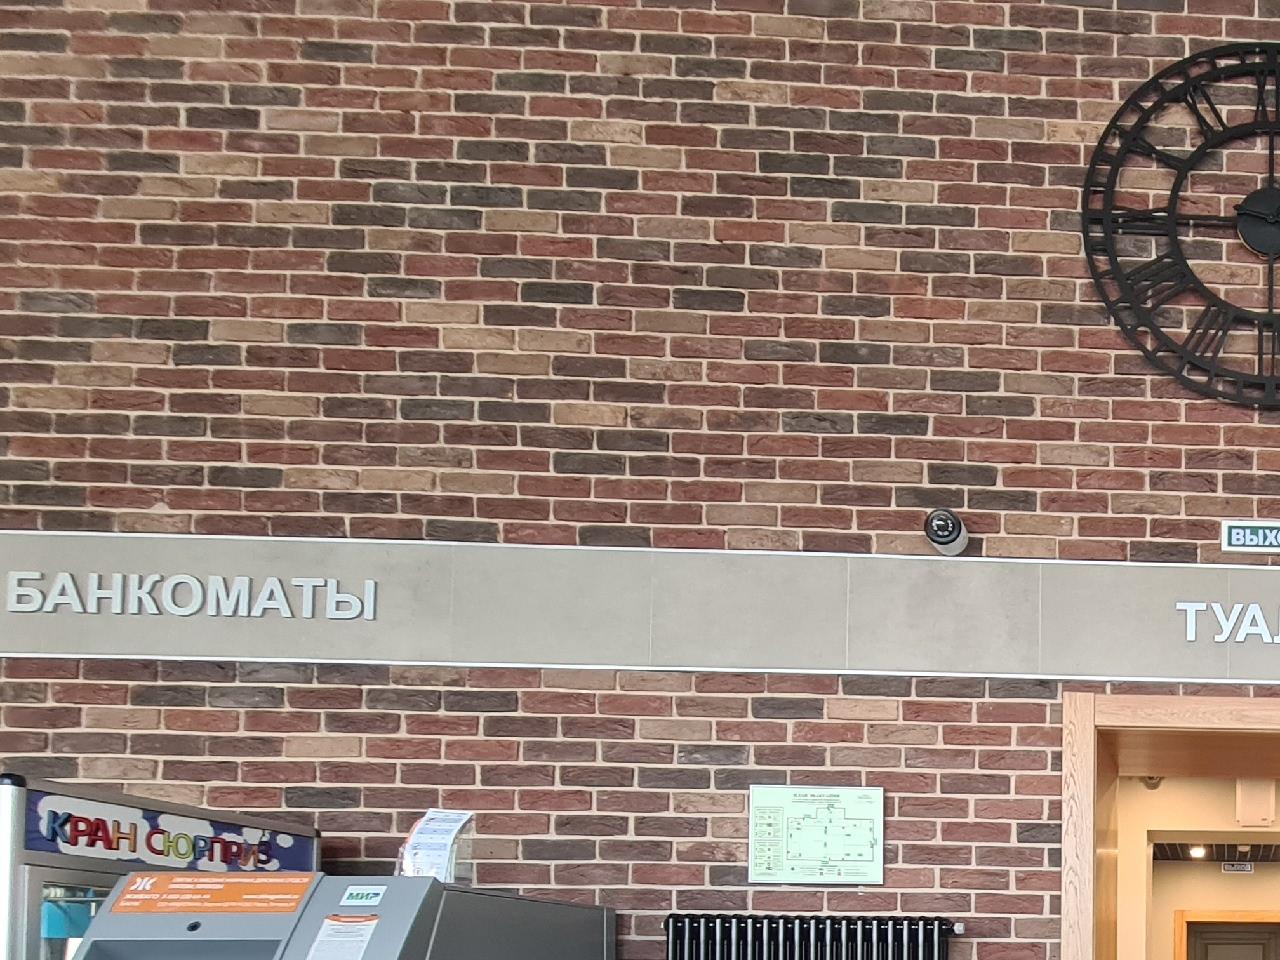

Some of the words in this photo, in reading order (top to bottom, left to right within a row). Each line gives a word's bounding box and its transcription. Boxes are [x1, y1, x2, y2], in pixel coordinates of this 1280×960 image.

[5, 571, 377, 621] БАНКОМАТЫ
[46, 809, 138, 853] КРАН
[146, 829, 272, 867] СЮРПРИЗ
[346, 892, 381, 902] МИР
